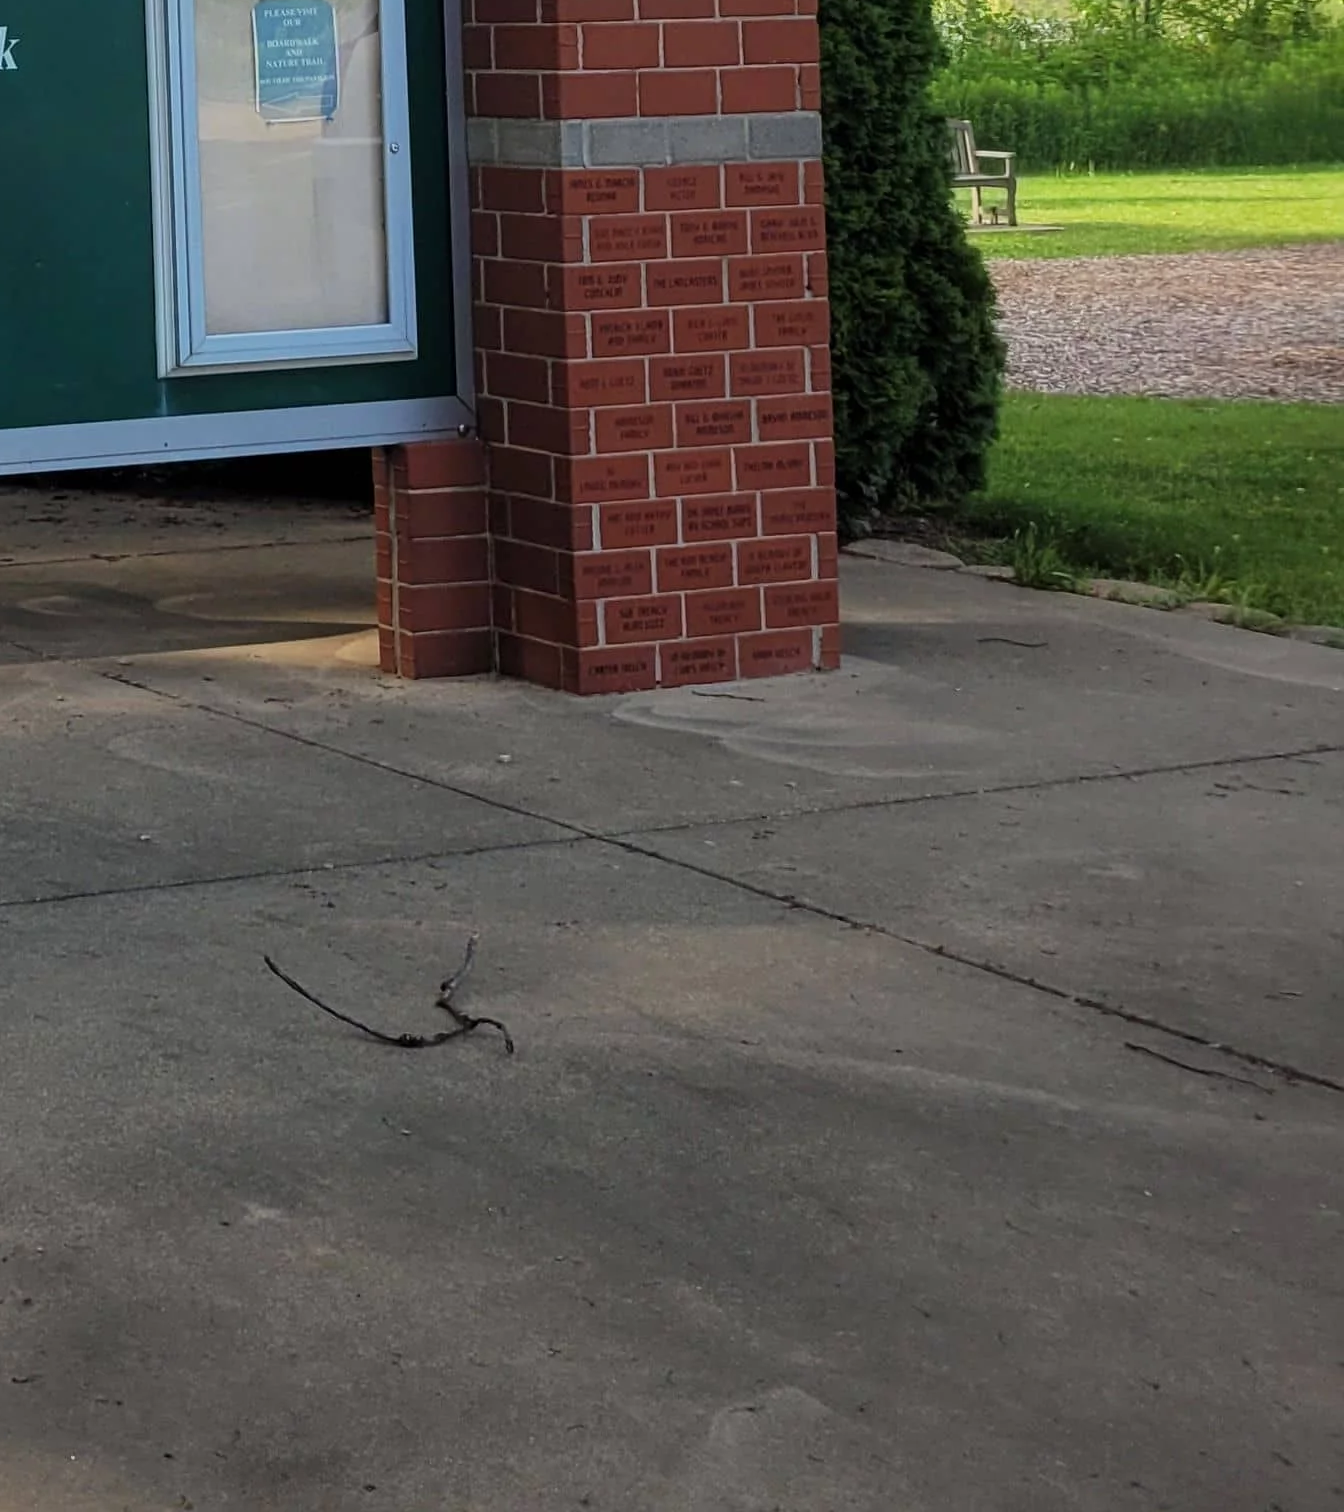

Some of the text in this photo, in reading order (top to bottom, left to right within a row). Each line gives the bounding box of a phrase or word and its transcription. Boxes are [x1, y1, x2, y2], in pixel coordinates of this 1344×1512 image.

[264, 8, 296, 18] PLEASE
[283, 18, 302, 27] OUR
[266, 38, 319, 49] BOARDWALK
[285, 48, 304, 57] AND
[265, 56, 325, 69] NATURE TRAIL
